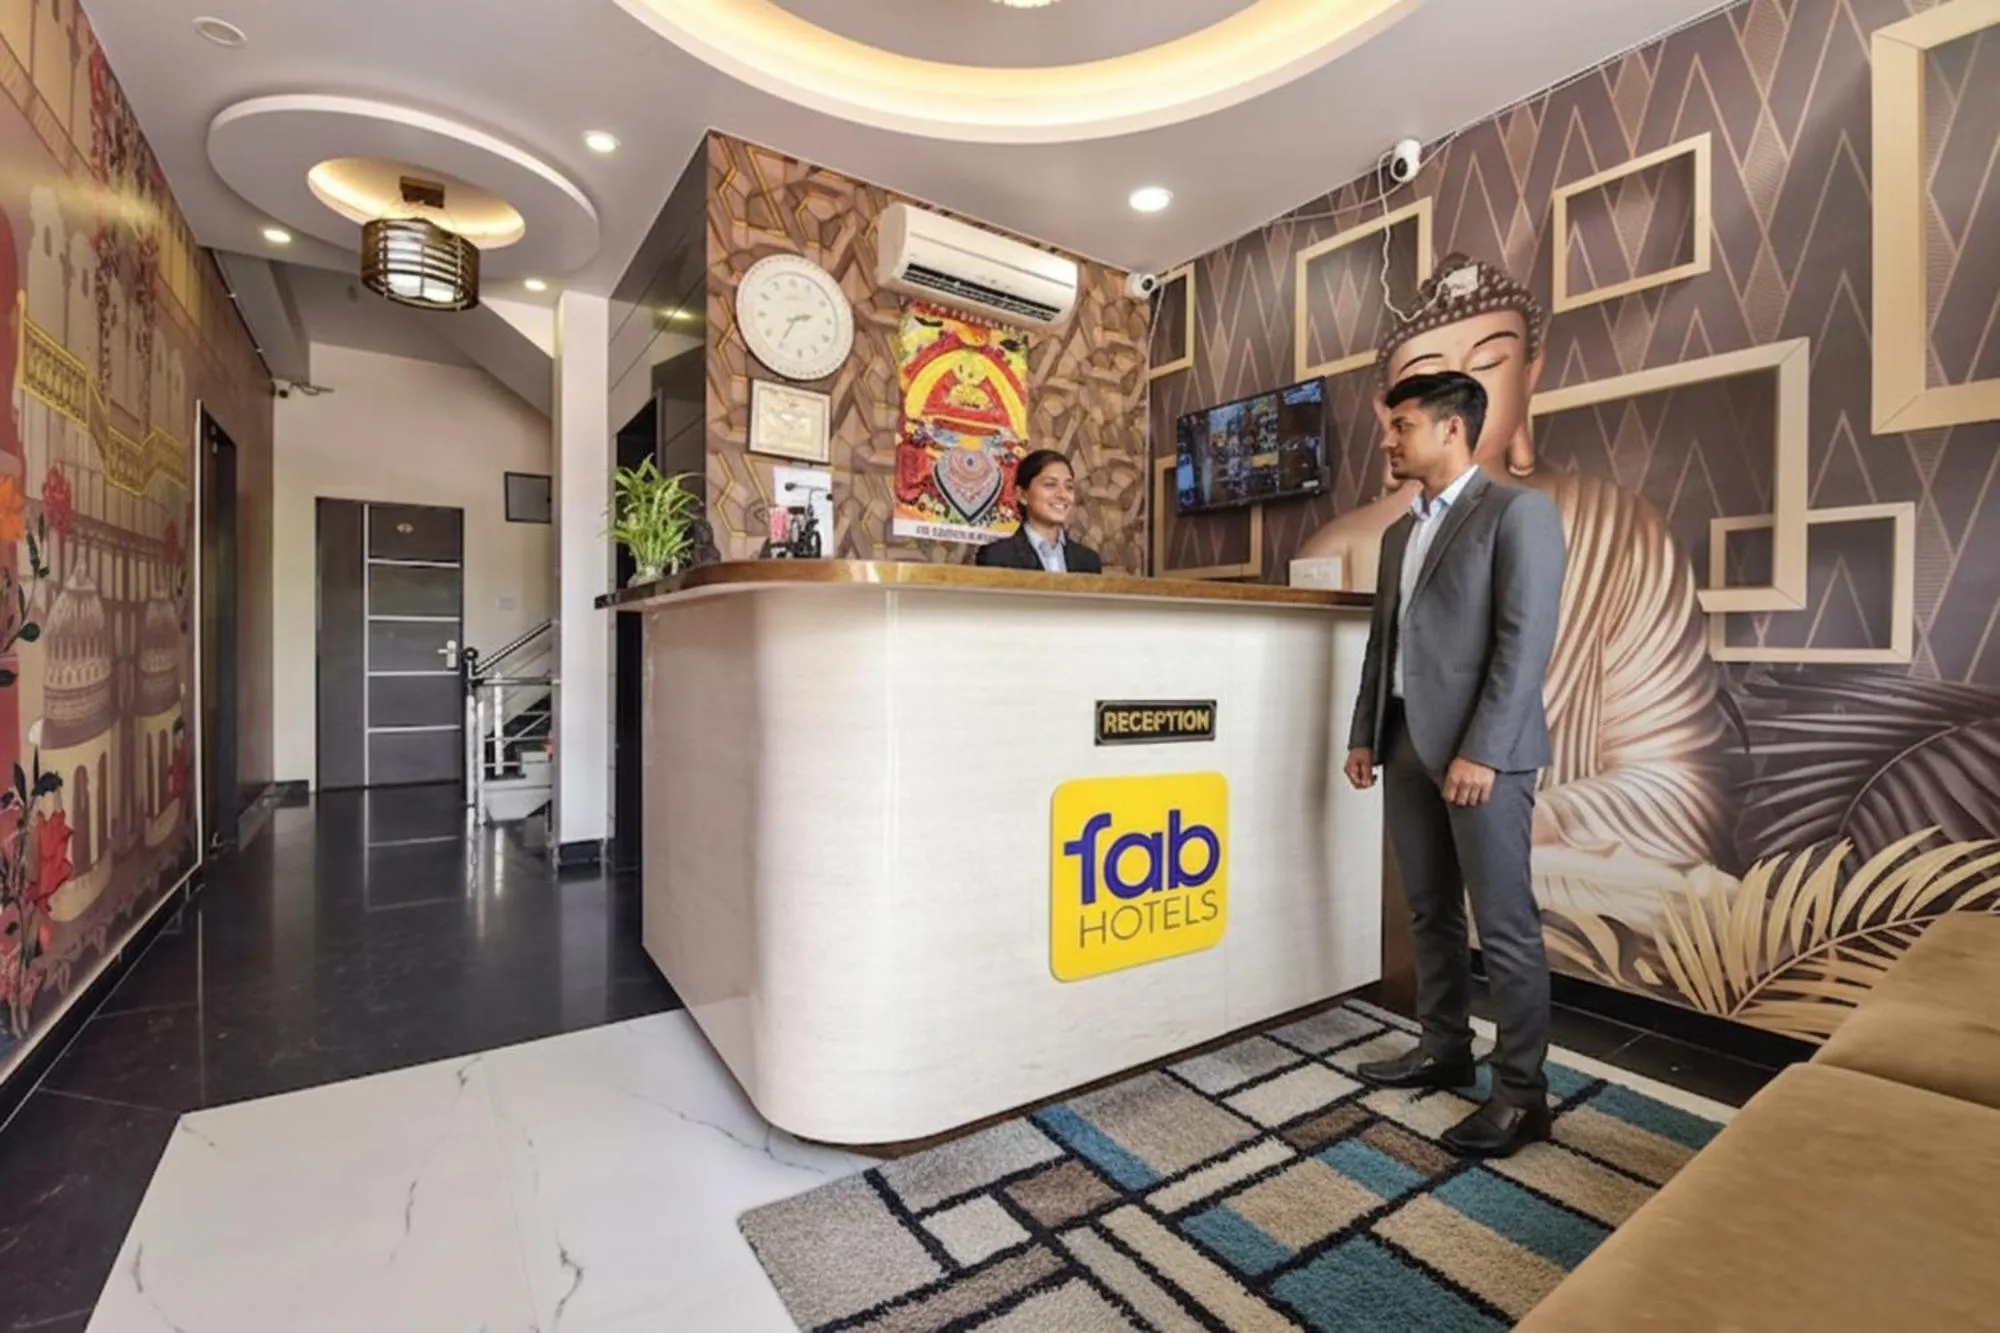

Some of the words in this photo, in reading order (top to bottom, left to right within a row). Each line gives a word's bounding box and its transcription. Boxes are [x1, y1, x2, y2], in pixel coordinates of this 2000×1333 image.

[1103, 709, 1210, 734] RECEPTION
[1063, 809, 1221, 905] fab
[1079, 889, 1219, 948] HOTELS
